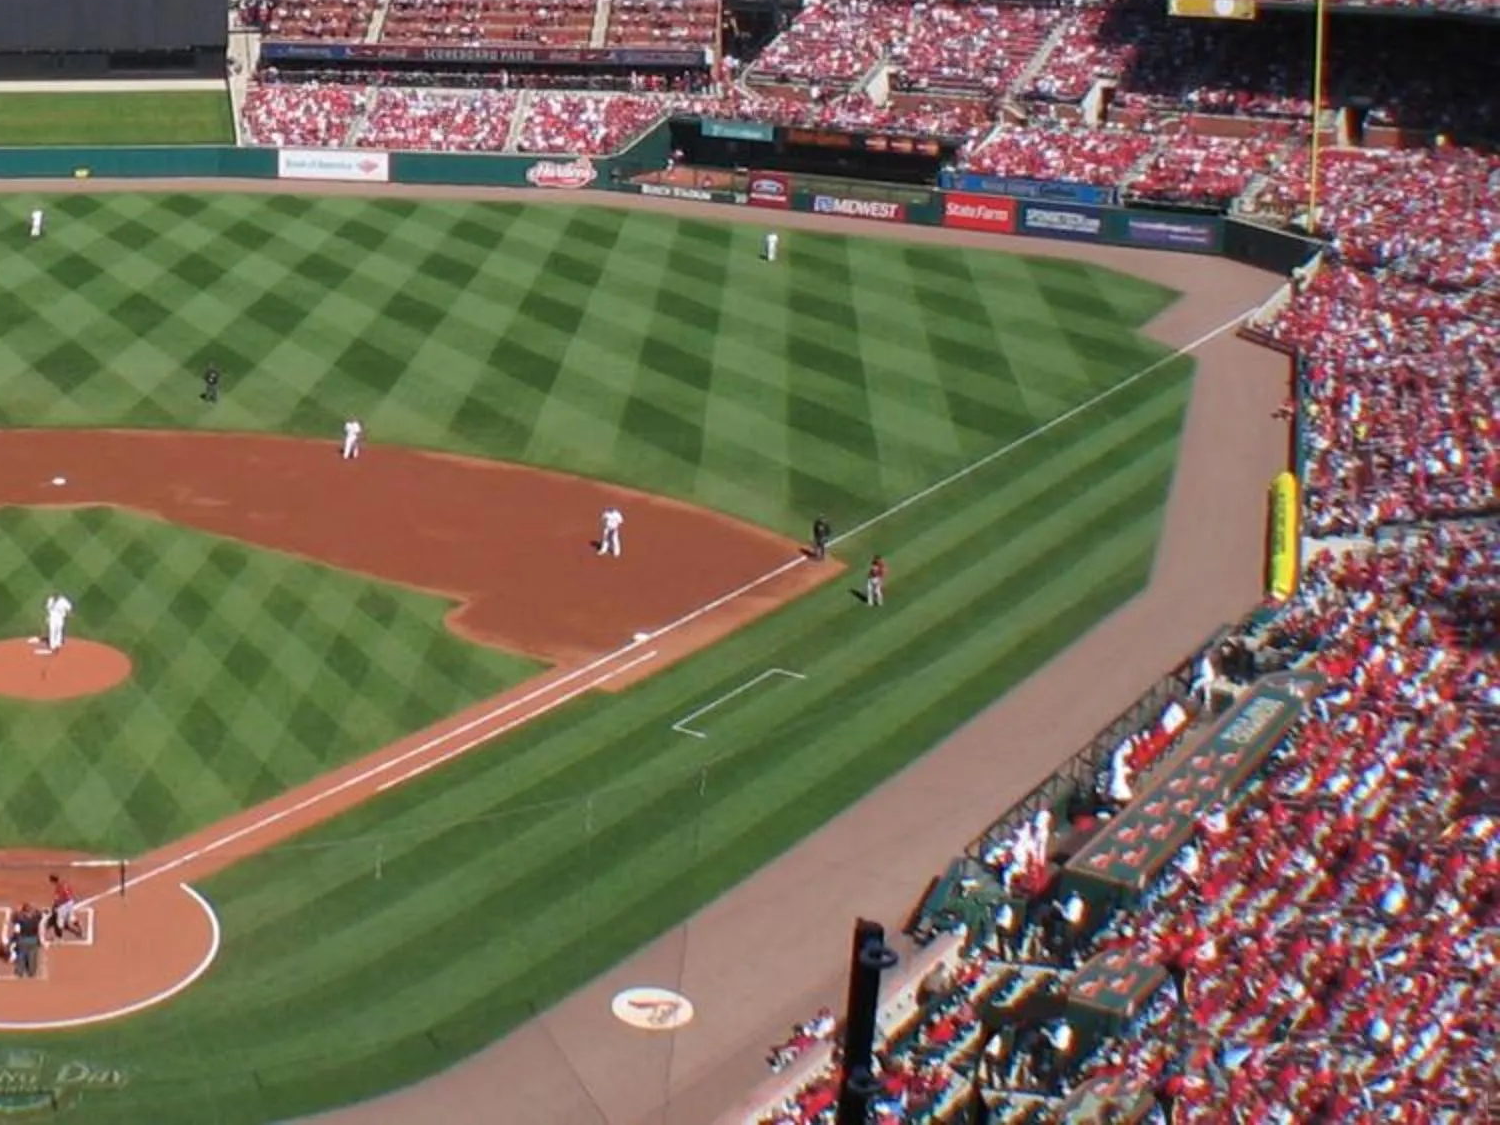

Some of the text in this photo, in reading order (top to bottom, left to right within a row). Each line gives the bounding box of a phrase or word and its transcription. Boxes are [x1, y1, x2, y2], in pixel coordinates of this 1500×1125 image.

[833, 197, 898, 218] MIDWEST
[945, 201, 976, 217] State
[976, 206, 1008, 221] Farm
